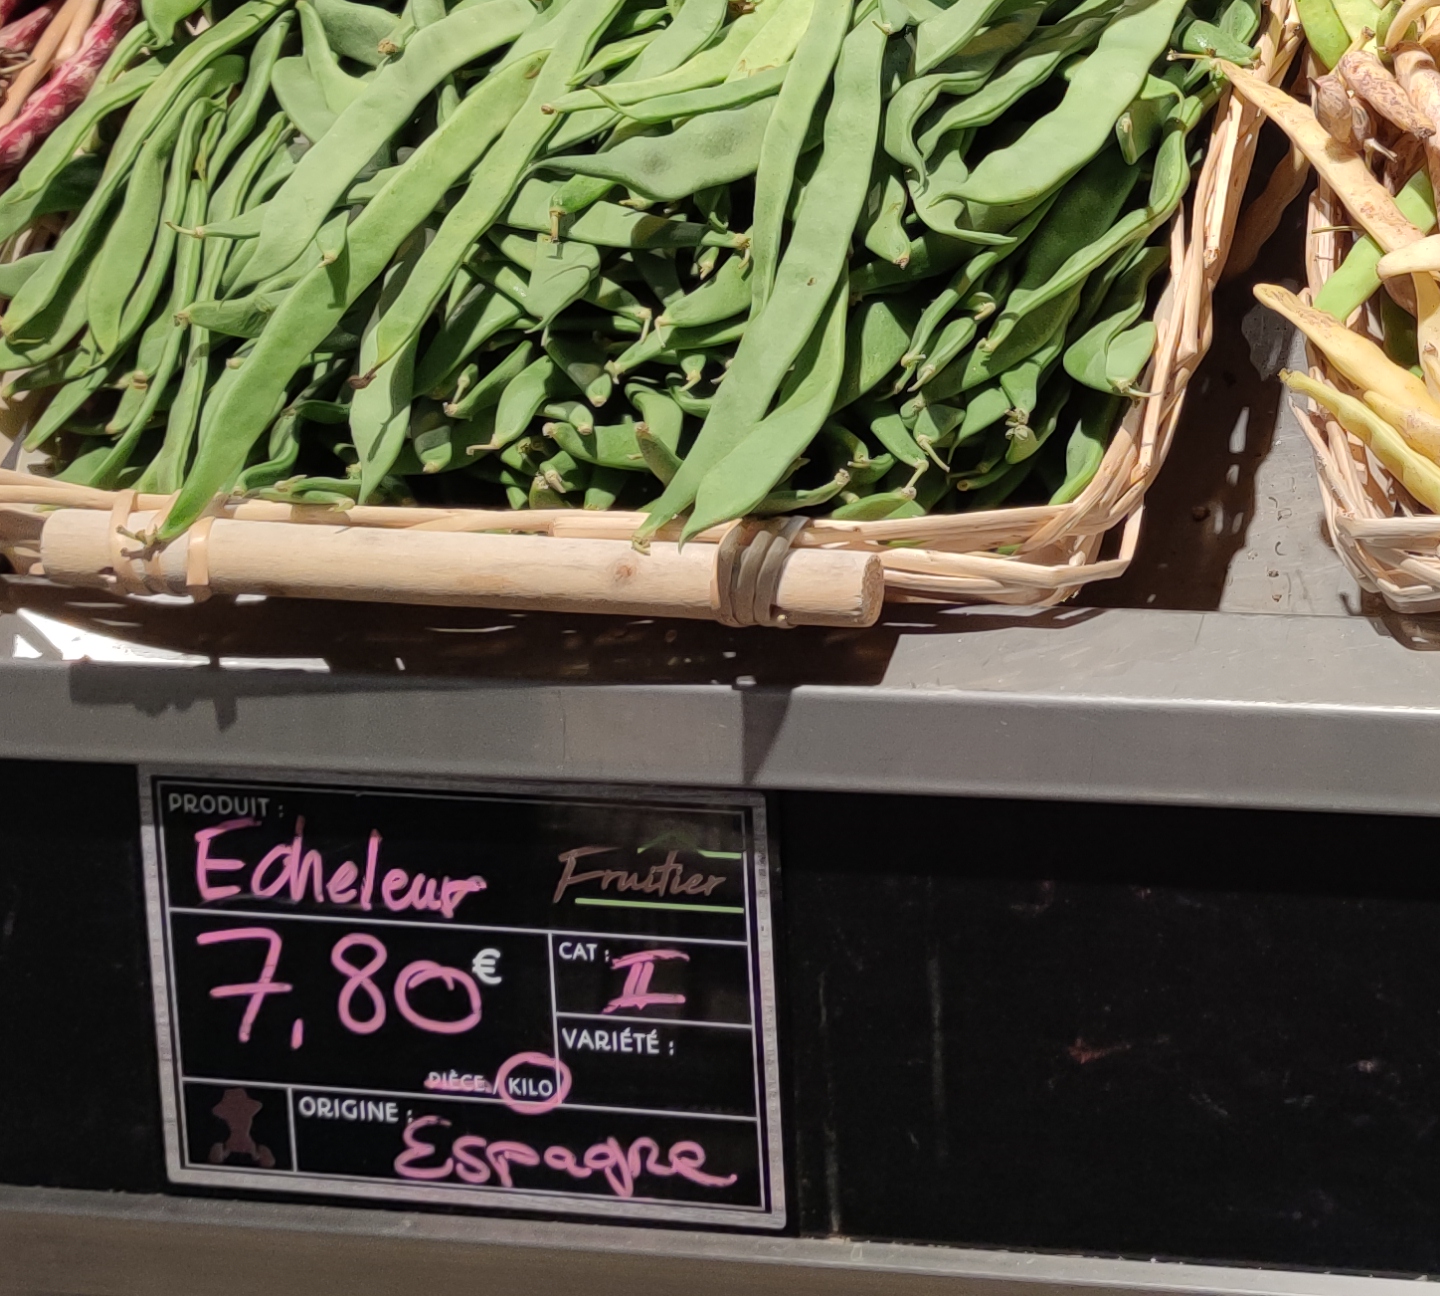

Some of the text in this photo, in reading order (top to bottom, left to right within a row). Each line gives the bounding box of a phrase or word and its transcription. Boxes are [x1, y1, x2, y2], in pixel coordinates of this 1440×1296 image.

[168, 793, 271, 817] PRODUIT
[553, 846, 727, 903] Fruitier
[559, 941, 598, 962] CAT
[196, 927, 502, 1049] 7,80 €
[561, 1026, 660, 1055] VARIÉTÉ
[508, 1076, 555, 1097] KILO
[298, 1096, 399, 1124] ORIGINE
